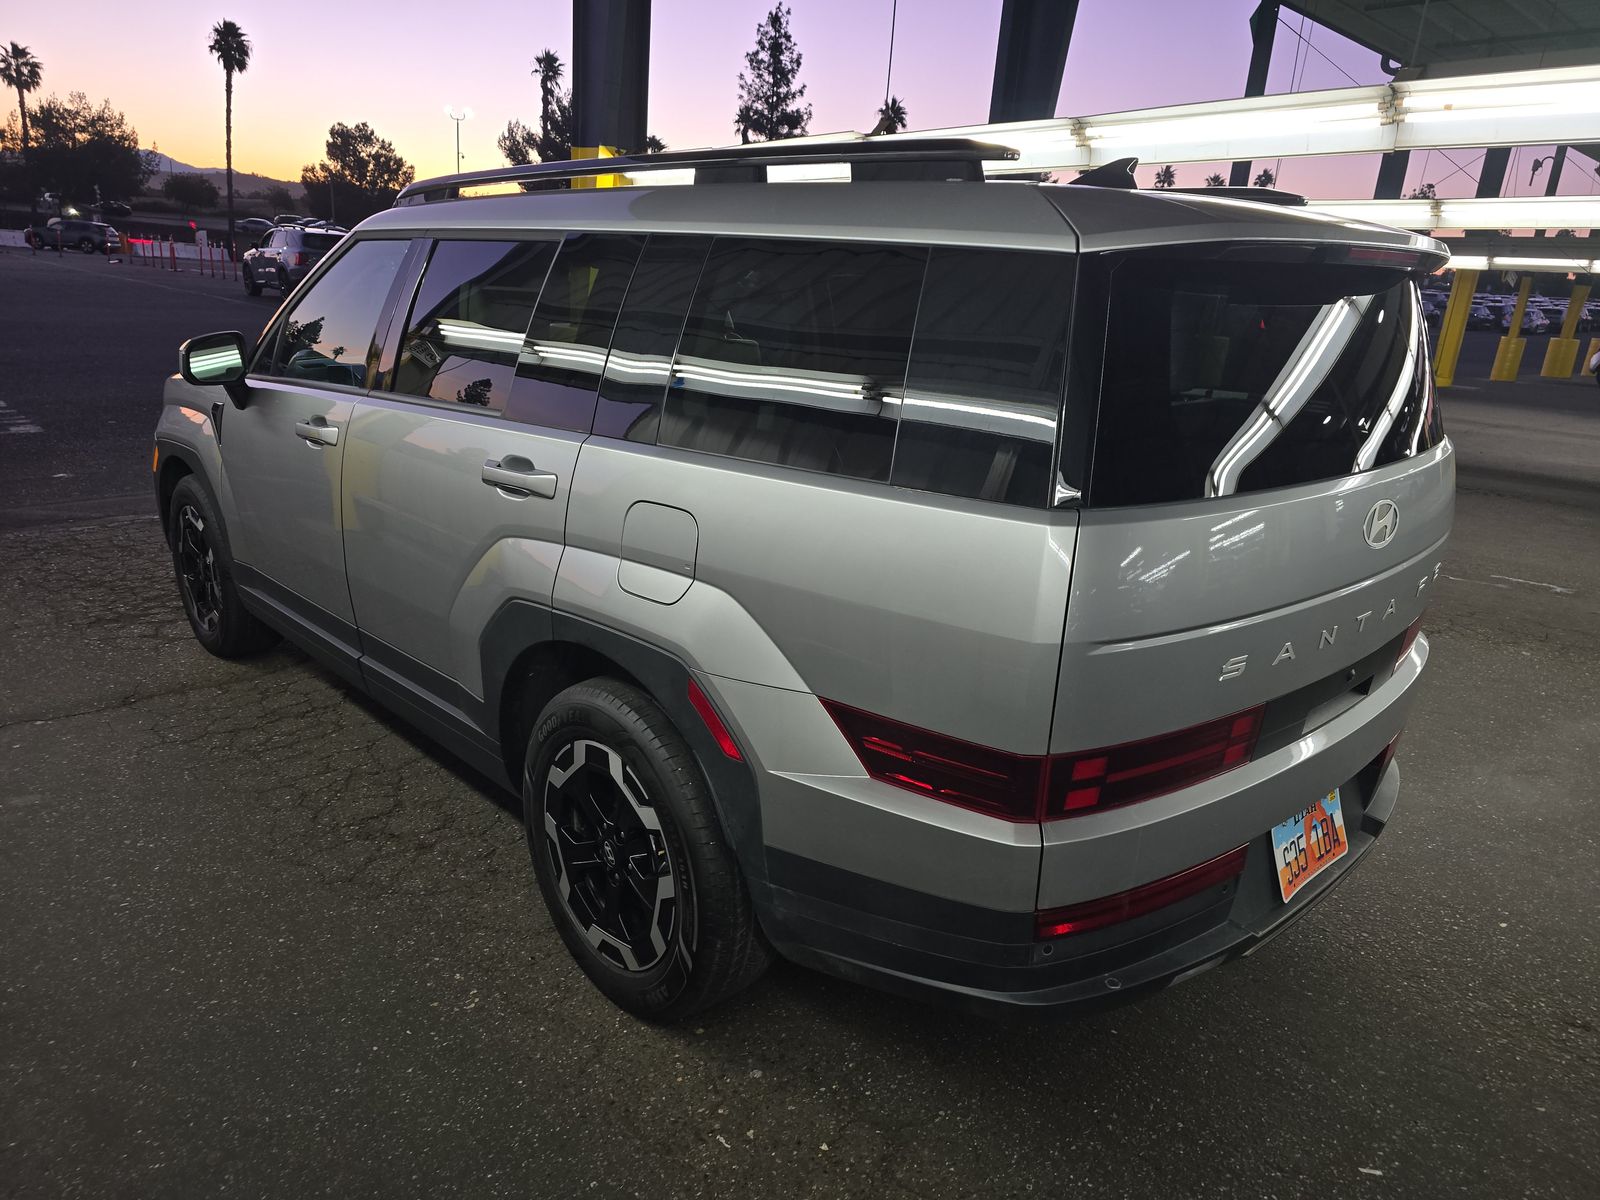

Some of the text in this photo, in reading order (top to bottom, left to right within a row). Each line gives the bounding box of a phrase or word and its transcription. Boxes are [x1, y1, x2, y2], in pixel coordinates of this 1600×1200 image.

[1218, 561, 1442, 682] SANTA FE
[537, 709, 590, 743] GOODEA
[1293, 802, 1317, 826] UTAH
[1282, 834, 1309, 886] S35
[1311, 812, 1341, 861] 1BA
